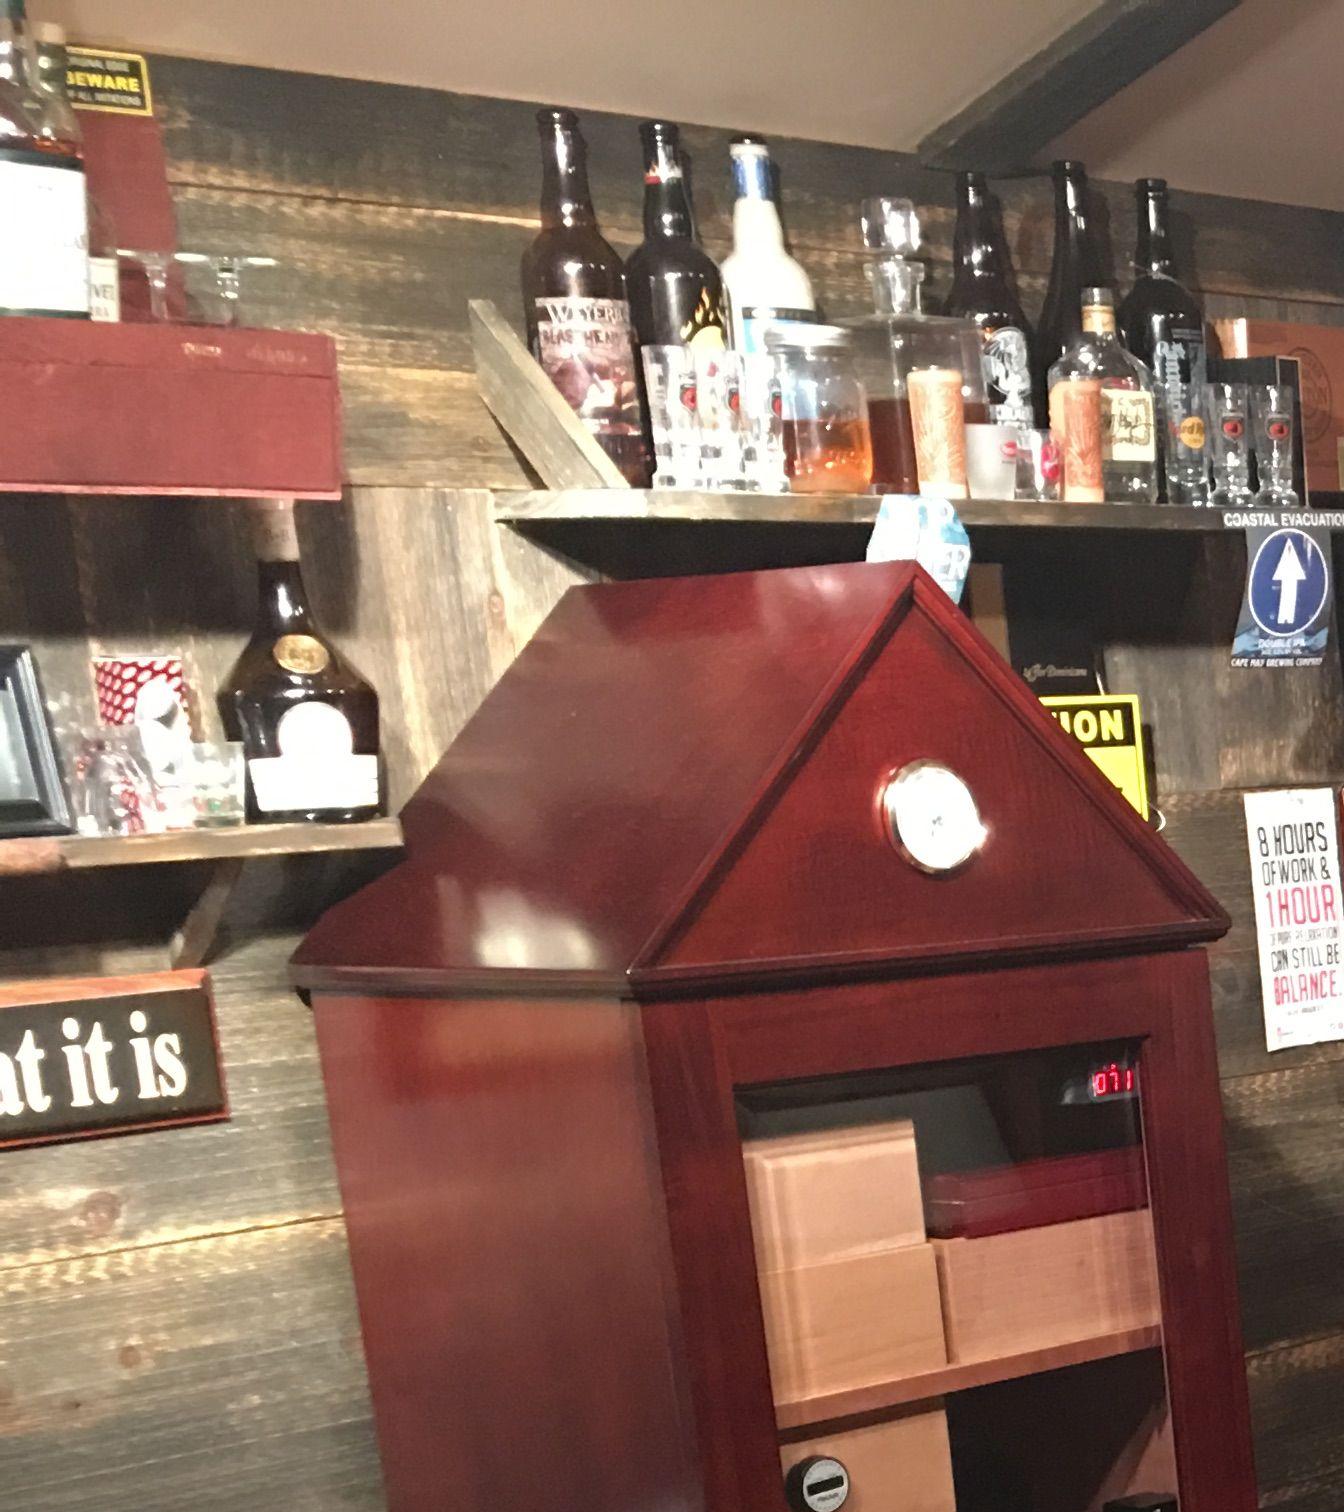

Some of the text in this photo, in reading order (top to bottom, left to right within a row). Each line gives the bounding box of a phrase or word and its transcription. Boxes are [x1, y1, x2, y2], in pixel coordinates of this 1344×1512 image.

[1223, 513, 1278, 527] COASTAL
[1052, 710, 1124, 743] ION
[1257, 821, 1328, 857] 8 HOURS
[1261, 856, 1331, 886] OF WORK &
[1265, 883, 1337, 928] 1 HOUR
[1271, 943, 1340, 973] CAN STILL BE
[61, 1017, 119, 1109] it
[129, 1010, 188, 1100] is
